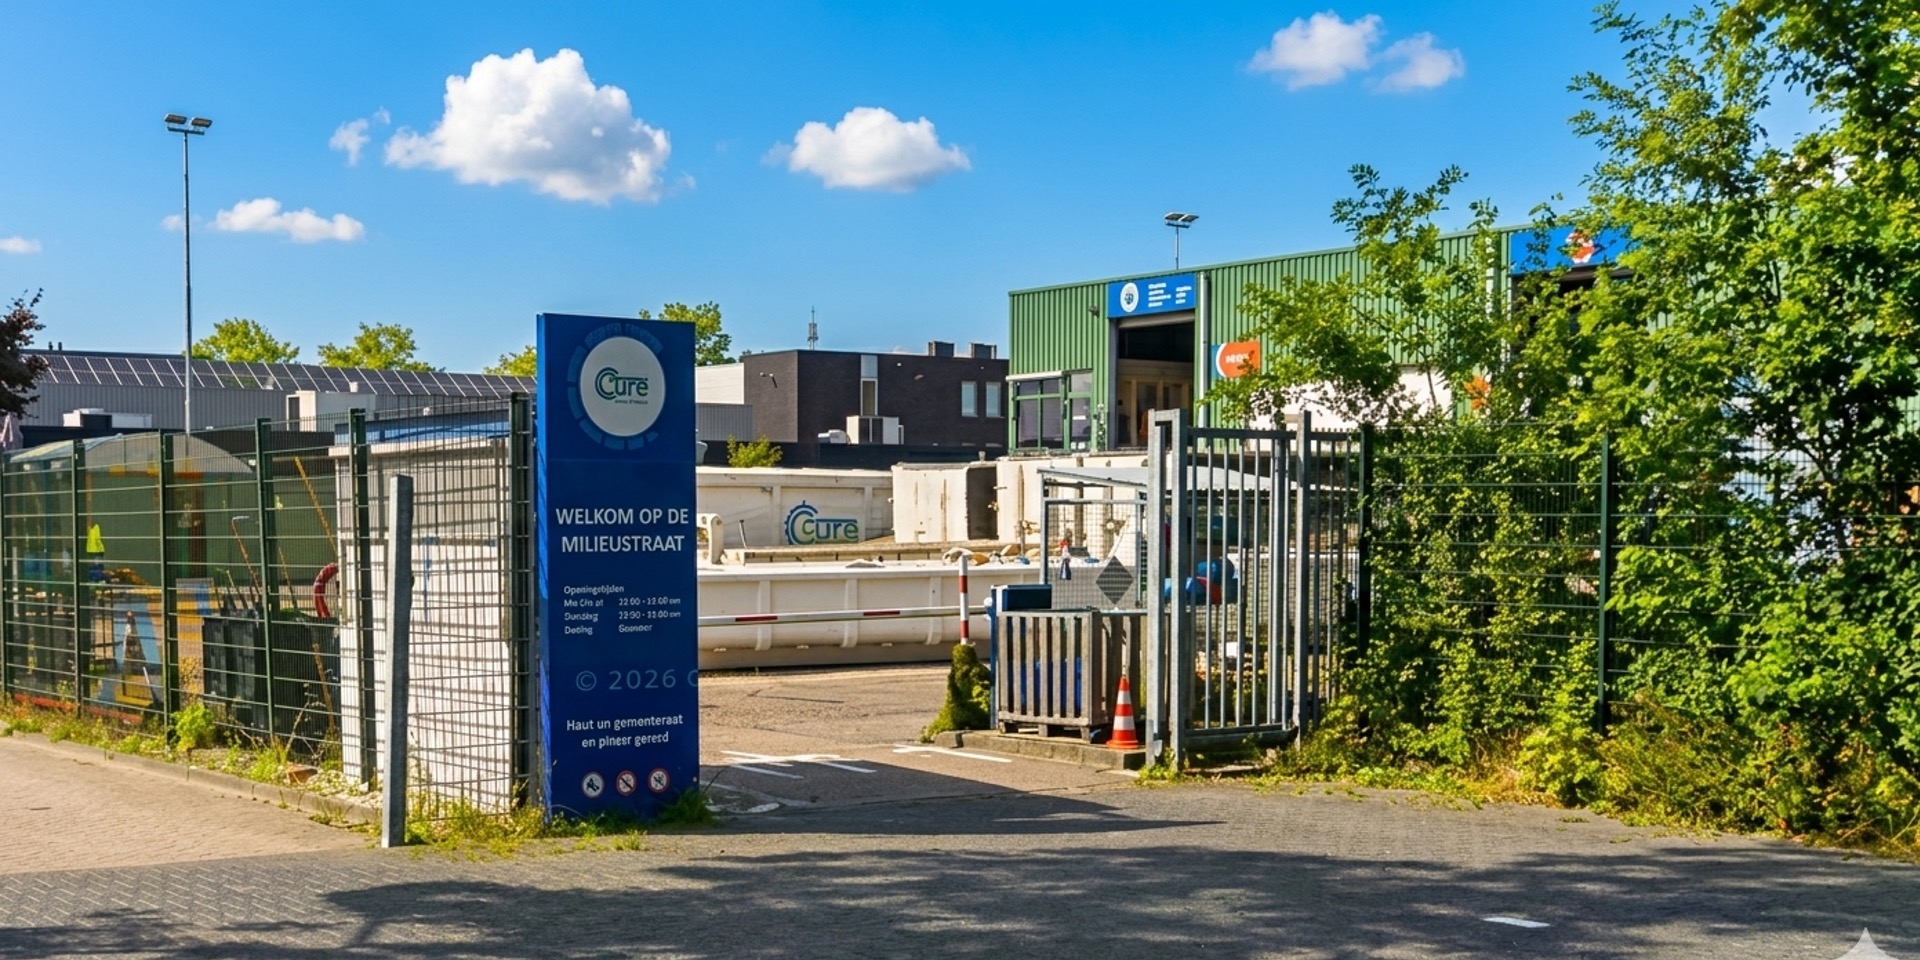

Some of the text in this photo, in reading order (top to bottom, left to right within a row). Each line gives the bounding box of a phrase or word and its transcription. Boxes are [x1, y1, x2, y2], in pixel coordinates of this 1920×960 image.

[556, 508, 689, 525] WELKOM OP DE
[562, 535, 685, 553] MILIEUSTRAAT
[566, 714, 683, 731] Haut un gementeraat
[581, 738, 595, 748] en
